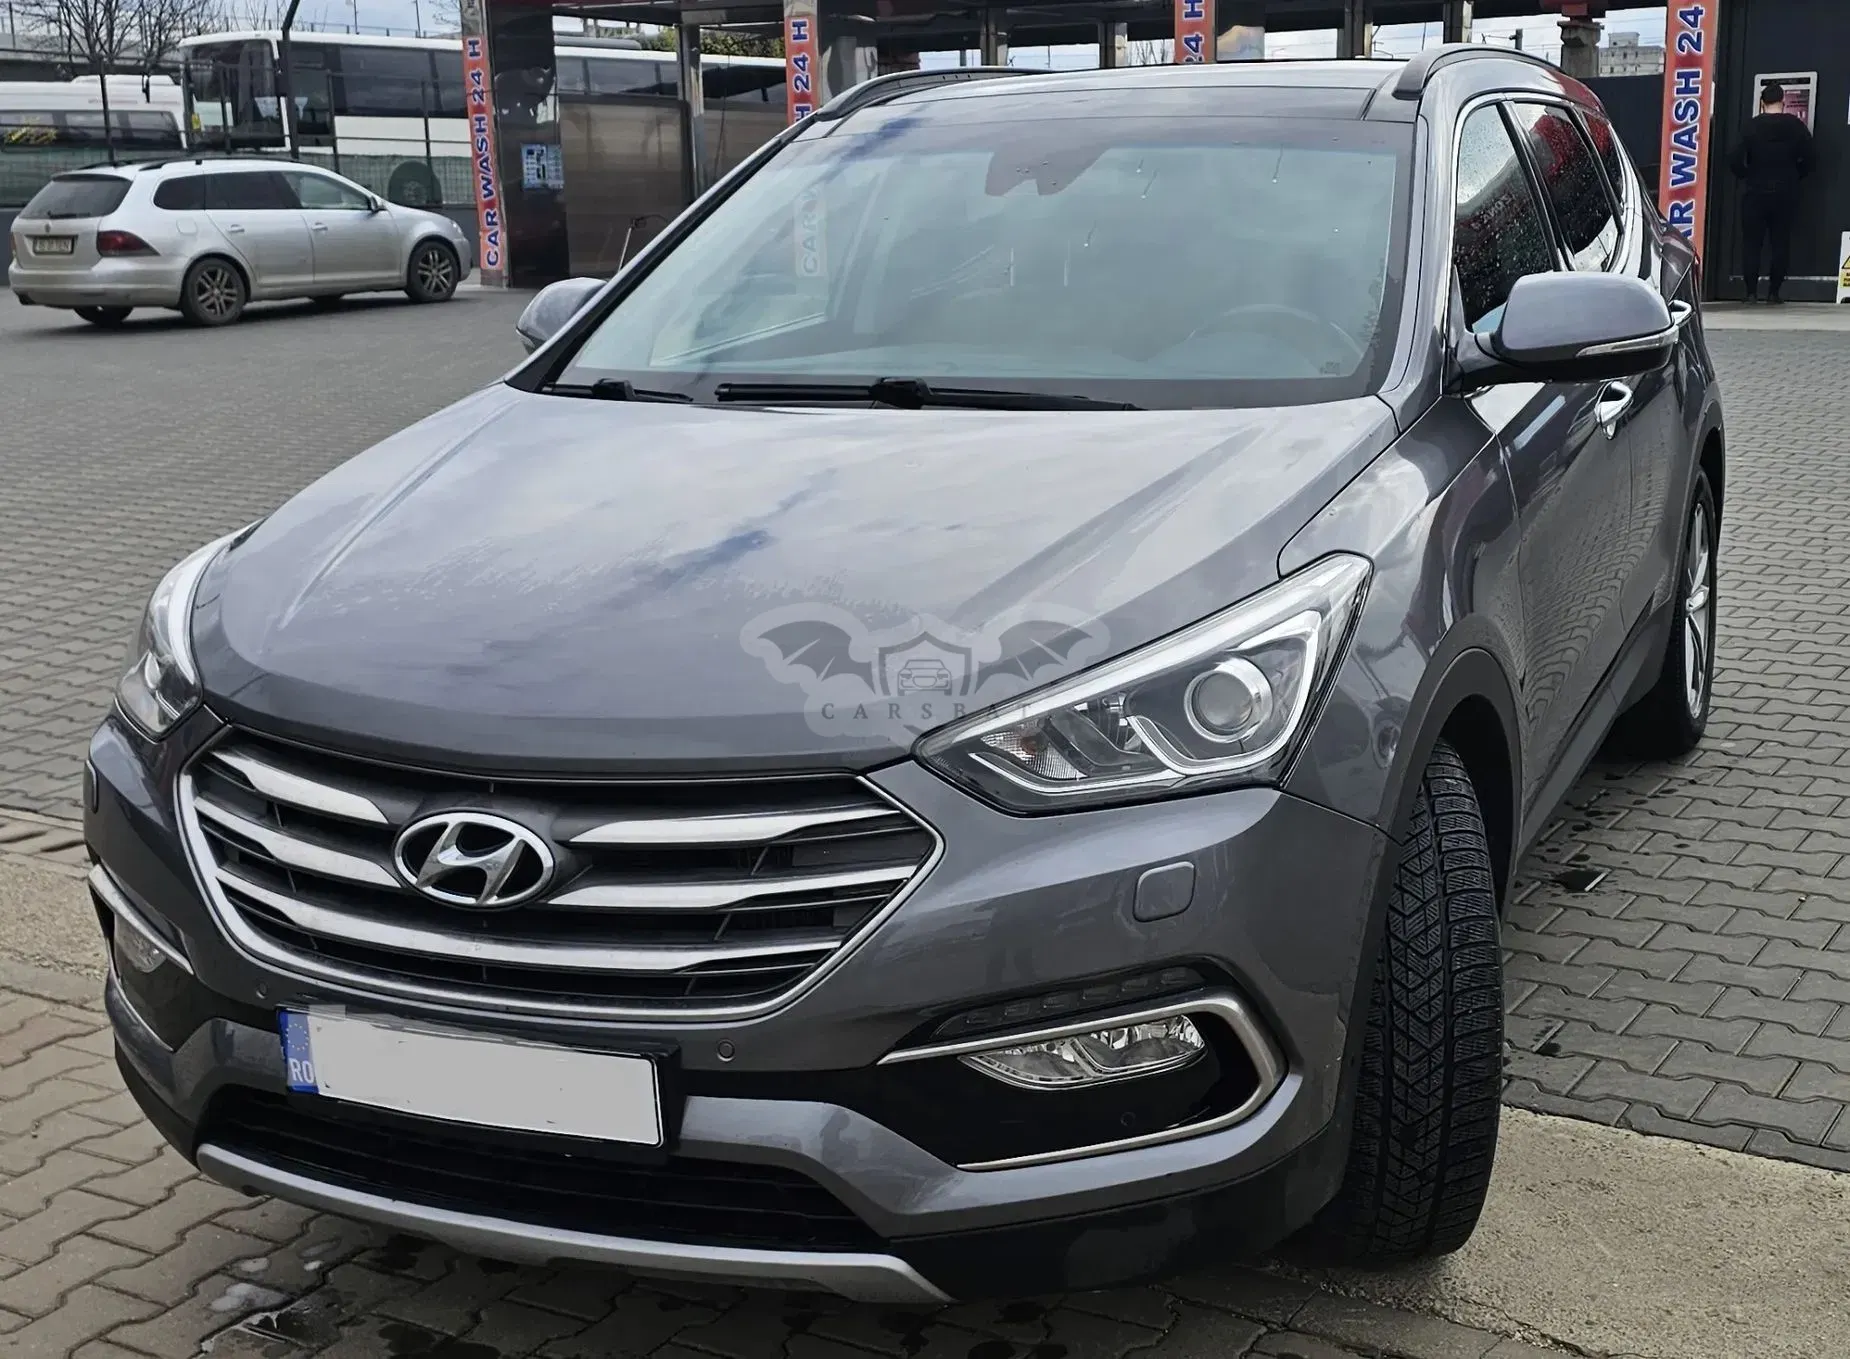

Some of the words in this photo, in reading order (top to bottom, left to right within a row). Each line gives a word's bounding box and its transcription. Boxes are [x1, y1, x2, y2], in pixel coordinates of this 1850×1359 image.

[1184, 0, 1203, 18] H
[791, 20, 808, 41] H
[1677, 5, 1704, 53] 24
[467, 38, 482, 58] H
[469, 69, 485, 104] 24
[793, 53, 810, 92] 24
[1671, 69, 1701, 187] WASH
[474, 115, 495, 200] WASH
[484, 208, 500, 268] CAR
[289, 1057, 315, 1084] RO
